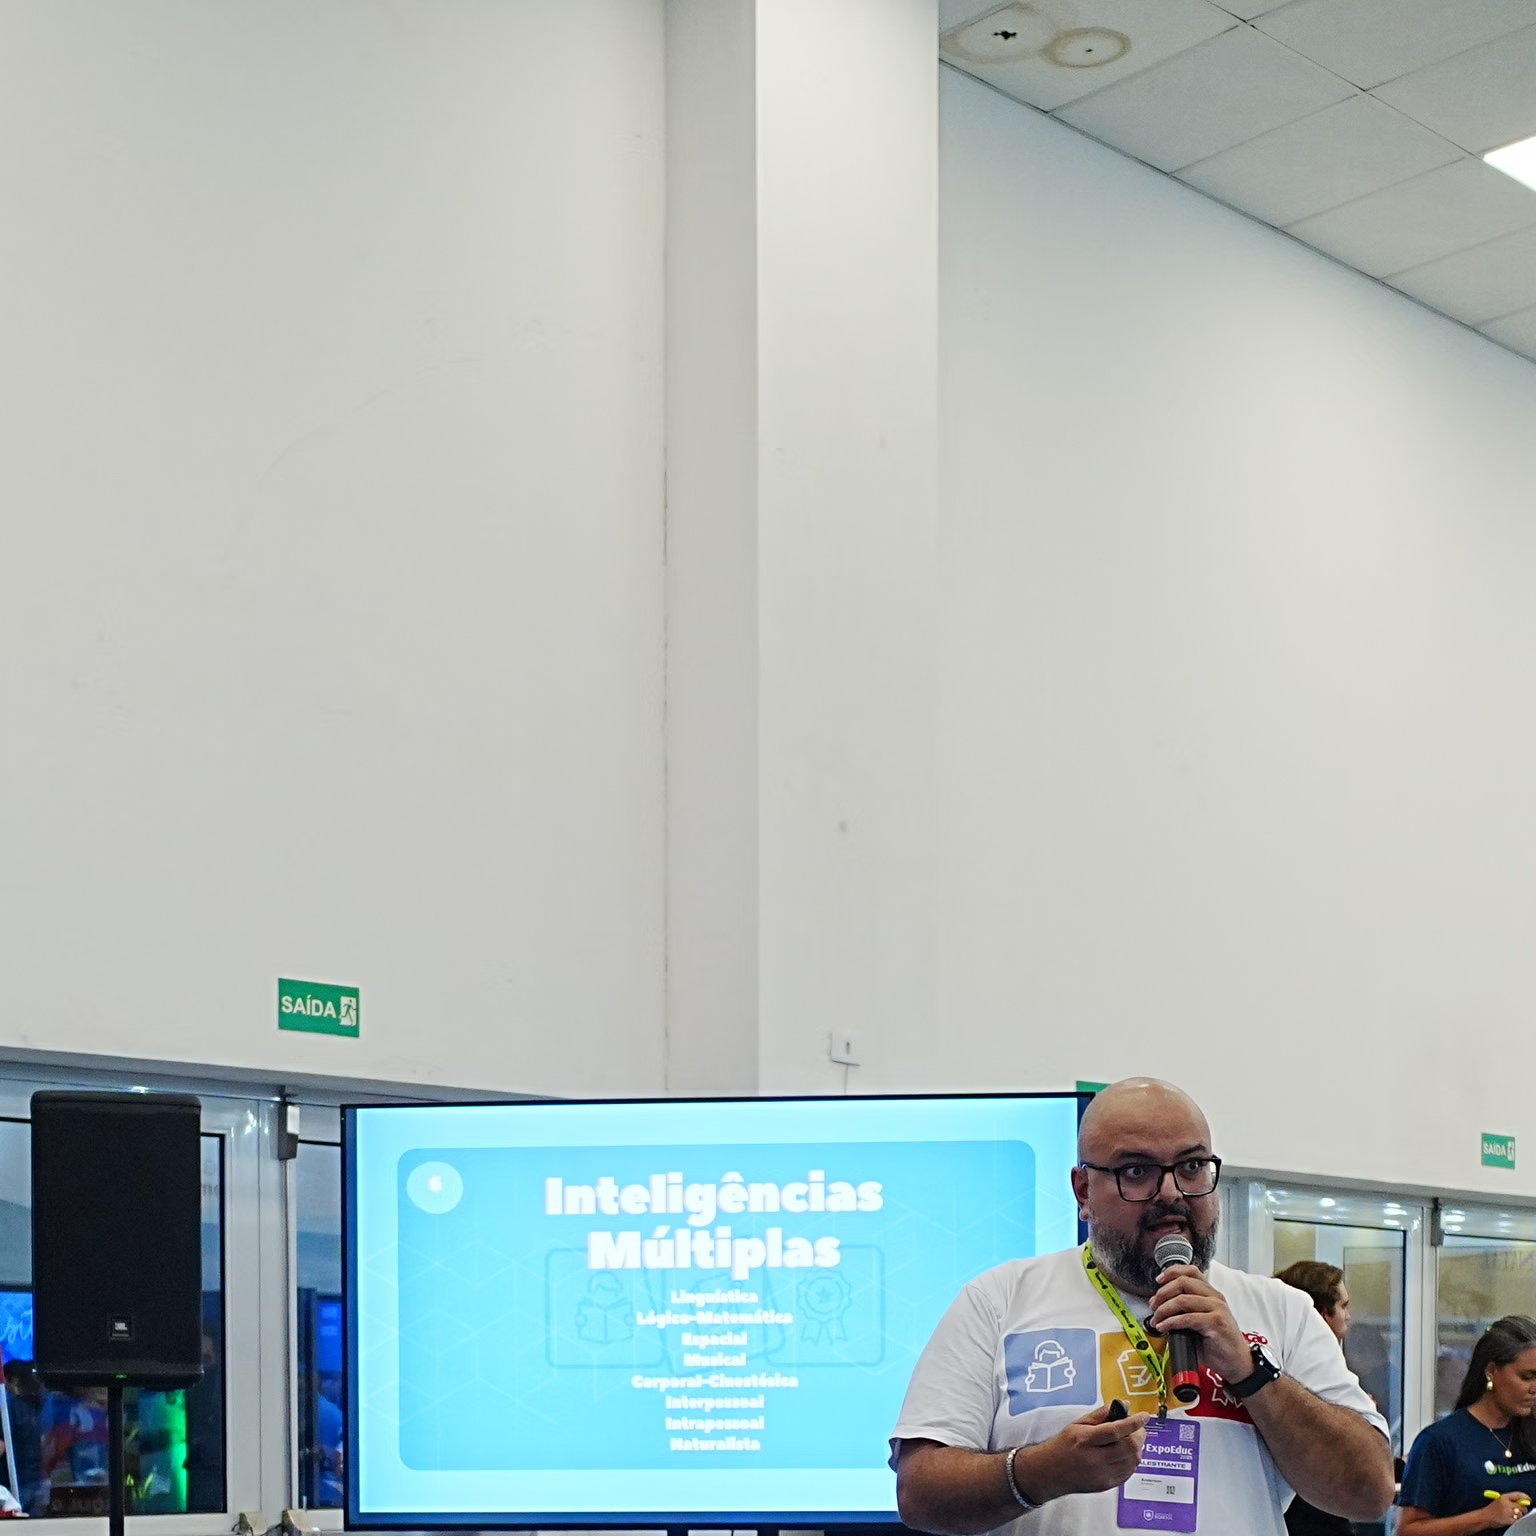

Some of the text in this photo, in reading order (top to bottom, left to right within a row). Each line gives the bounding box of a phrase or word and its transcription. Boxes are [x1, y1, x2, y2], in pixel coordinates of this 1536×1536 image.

[281, 994, 337, 1019] SAÍDA
[1483, 1140, 1507, 1157] SAÍDA
[545, 1169, 884, 1227] Inteligências
[588, 1225, 842, 1280] Múltiplas
[670, 1289, 759, 1308] Linguística
[636, 1309, 794, 1329] Lógico-Matemática
[681, 1331, 748, 1350] Espacial
[683, 1352, 747, 1367] Musical
[631, 1372, 800, 1393] Corporal-Cinestésica
[665, 1394, 765, 1413] Interpessoal
[665, 1415, 765, 1434] Intrapessoal
[669, 1436, 761, 1451] Naturalista
[1145, 1442, 1194, 1456] ExpoEduc
[1141, 1460, 1187, 1469] LESTRANTE
